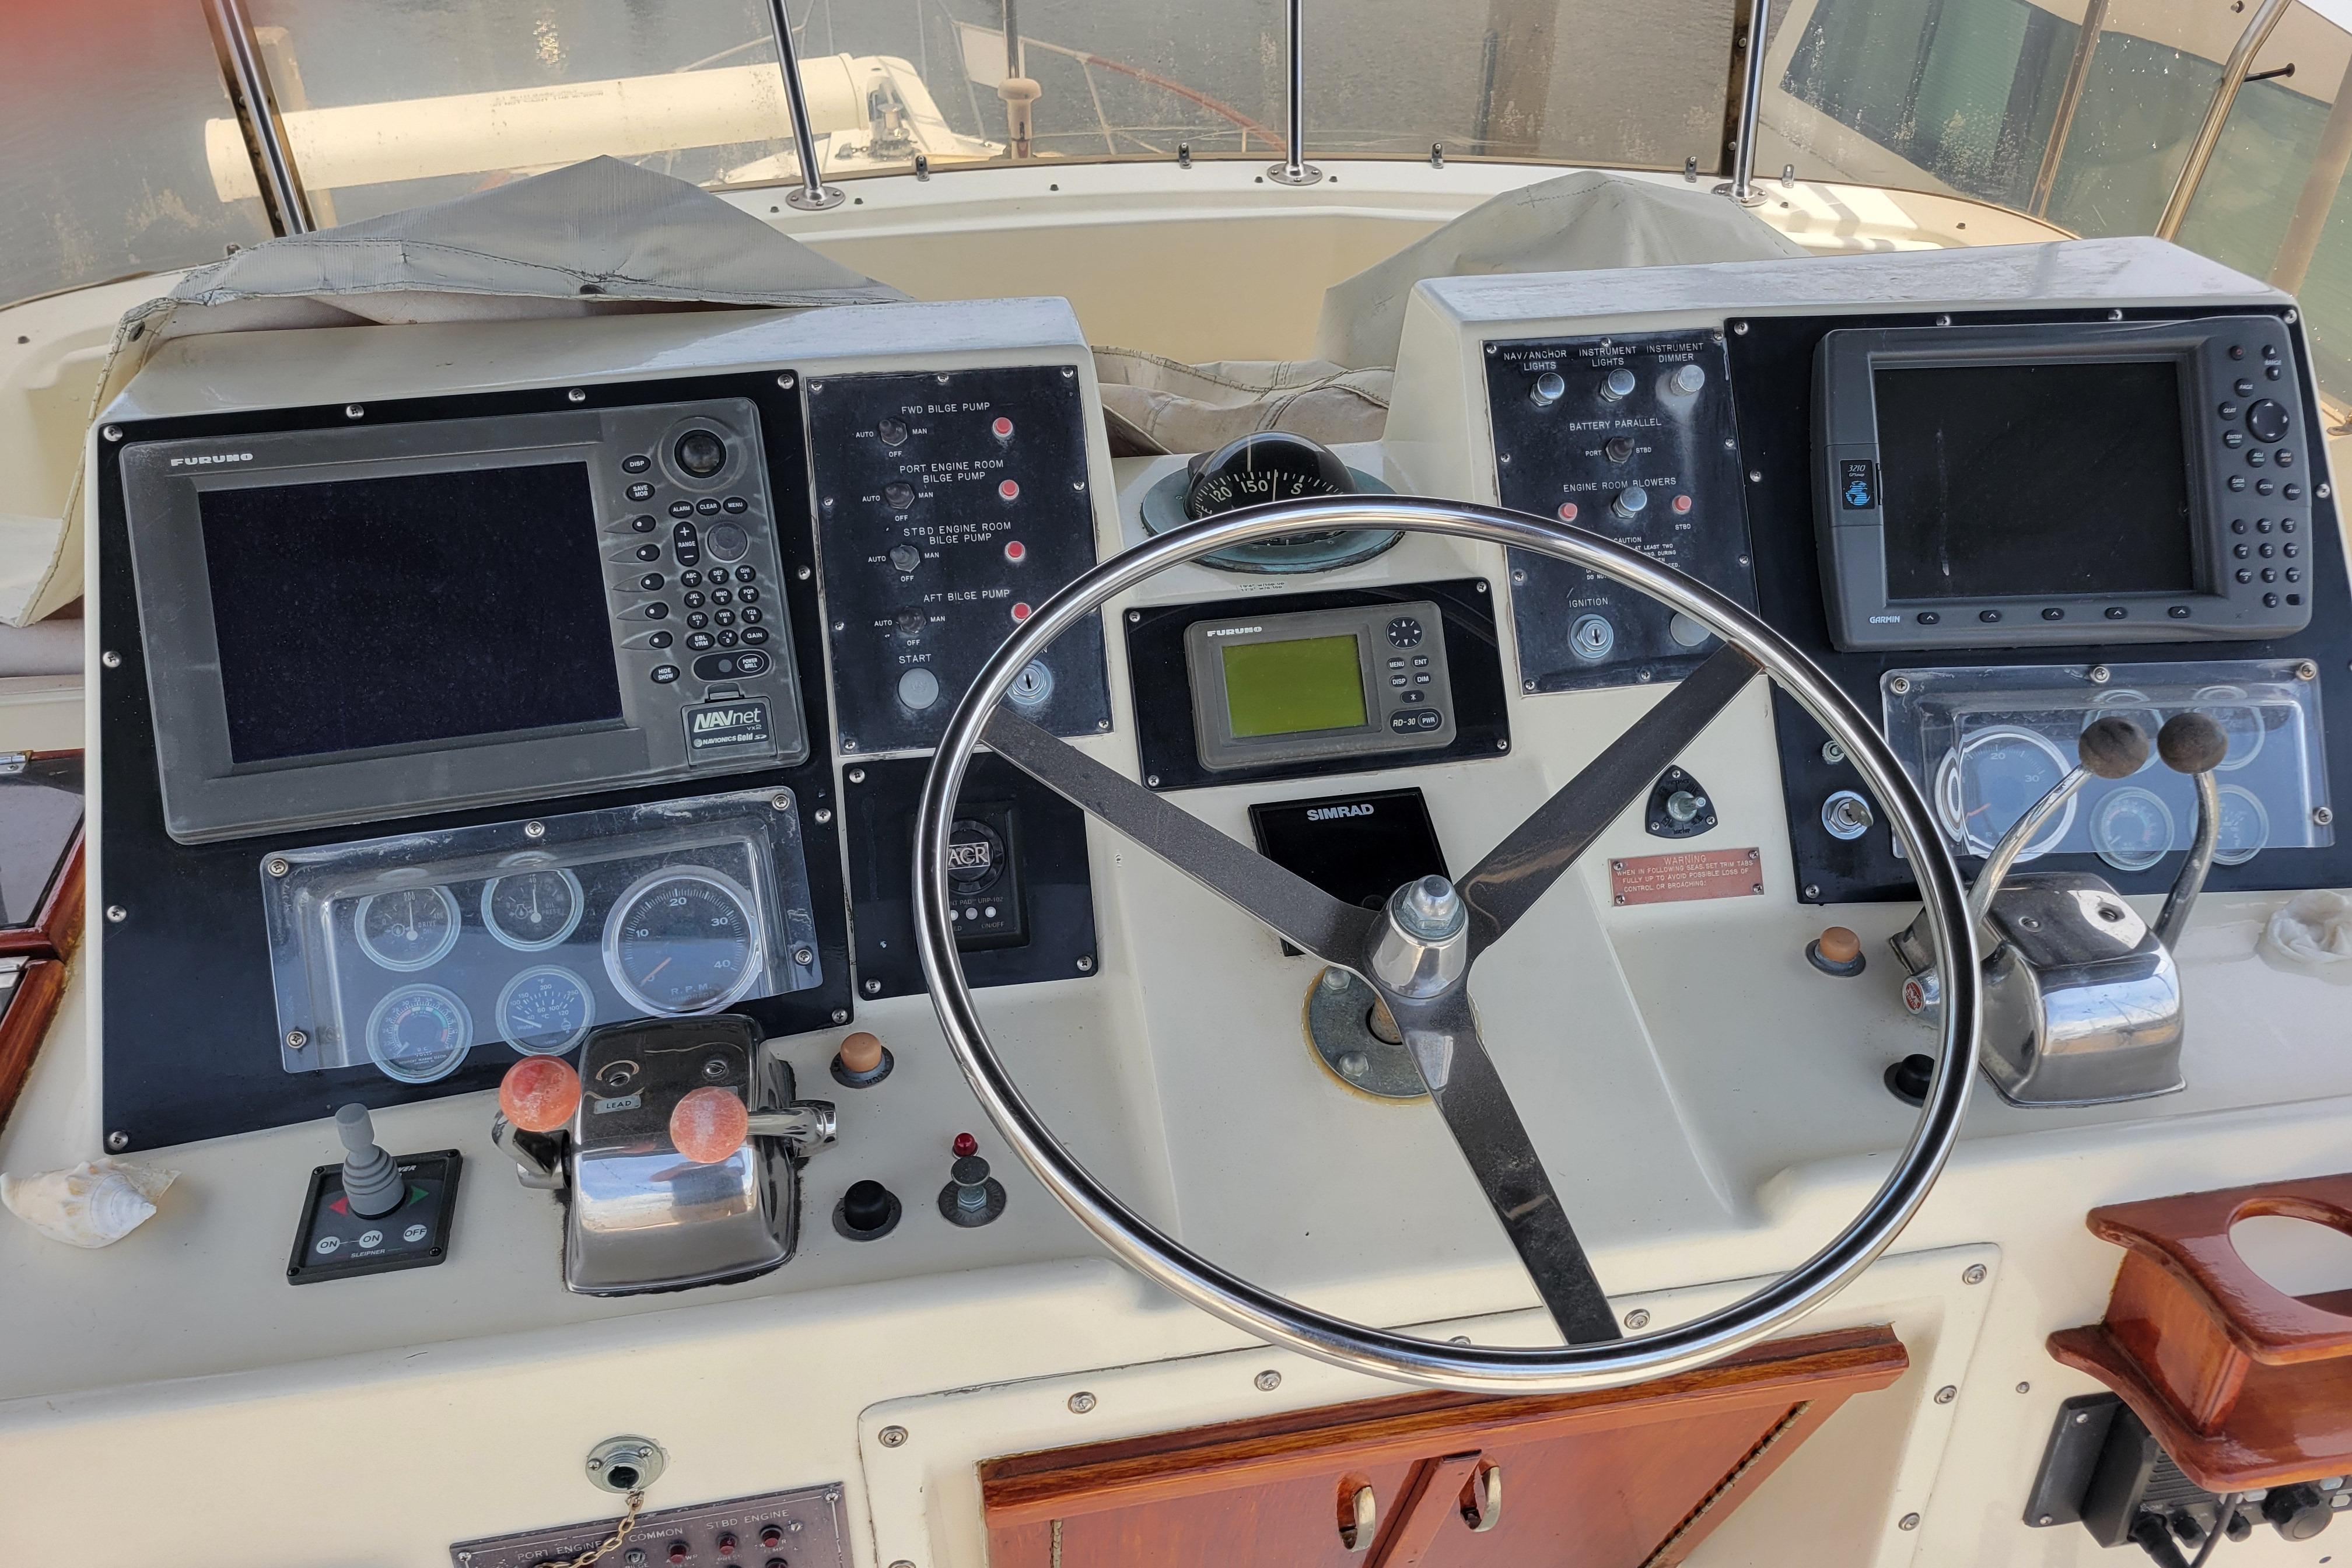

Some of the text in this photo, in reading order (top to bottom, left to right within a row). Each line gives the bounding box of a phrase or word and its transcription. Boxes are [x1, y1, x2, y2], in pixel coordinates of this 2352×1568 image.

[1579, 347, 1636, 357] INSTRUMENT
[1647, 343, 1703, 353] INSTRUMENT
[1504, 350, 1567, 360] NAV/ANCHOR
[1658, 354, 1694, 363] DIMMER
[1524, 362, 1556, 371] LIGHTS
[1592, 357, 1624, 367] LIGHTS
[901, 402, 990, 414] FWD BILGE PUMP
[1570, 418, 1661, 431] BATTERY PARALLEL
[171, 453, 253, 466] FURUNO
[900, 460, 1004, 474] PORT ENGINE ROOM
[923, 472, 985, 483] BILGE PUMP
[1241, 480, 1268, 494] 150
[1290, 483, 1303, 495] S
[1563, 477, 1676, 492] ENGINE ROOM BLOWERS
[1209, 488, 1233, 503] 120
[904, 522, 1011, 536] STBD ENGINE ROOM
[929, 533, 992, 545] BILGE PUMP
[923, 589, 1010, 603] AFT BILGE PUMP
[1569, 597, 1608, 608] IGNITION
[1208, 626, 1262, 636] FURUNO
[899, 654, 931, 664] START
[1414, 658, 1427, 666] ENT
[694, 708, 761, 732] NAVnet
[1392, 718, 1416, 727] RD-30
[1422, 716, 1435, 724] PWR
[703, 733, 753, 744] NAVIONICS Gold
[1307, 804, 1374, 821] SIMRAD
[948, 847, 988, 865] ACR
[1664, 855, 1706, 865] WARNING
[670, 897, 687, 907] 20
[711, 918, 728, 926] 30
[636, 929, 649, 937] 10
[713, 960, 730, 969] 40
[606, 1100, 631, 1108] LEAD
[405, 1228, 426, 1237] OFF
[321, 1240, 338, 1248] ON
[706, 1510, 789, 1530] STBD ENGINE
[629, 1527, 683, 1542] COMMON
[518, 1550, 548, 1560] PORT
